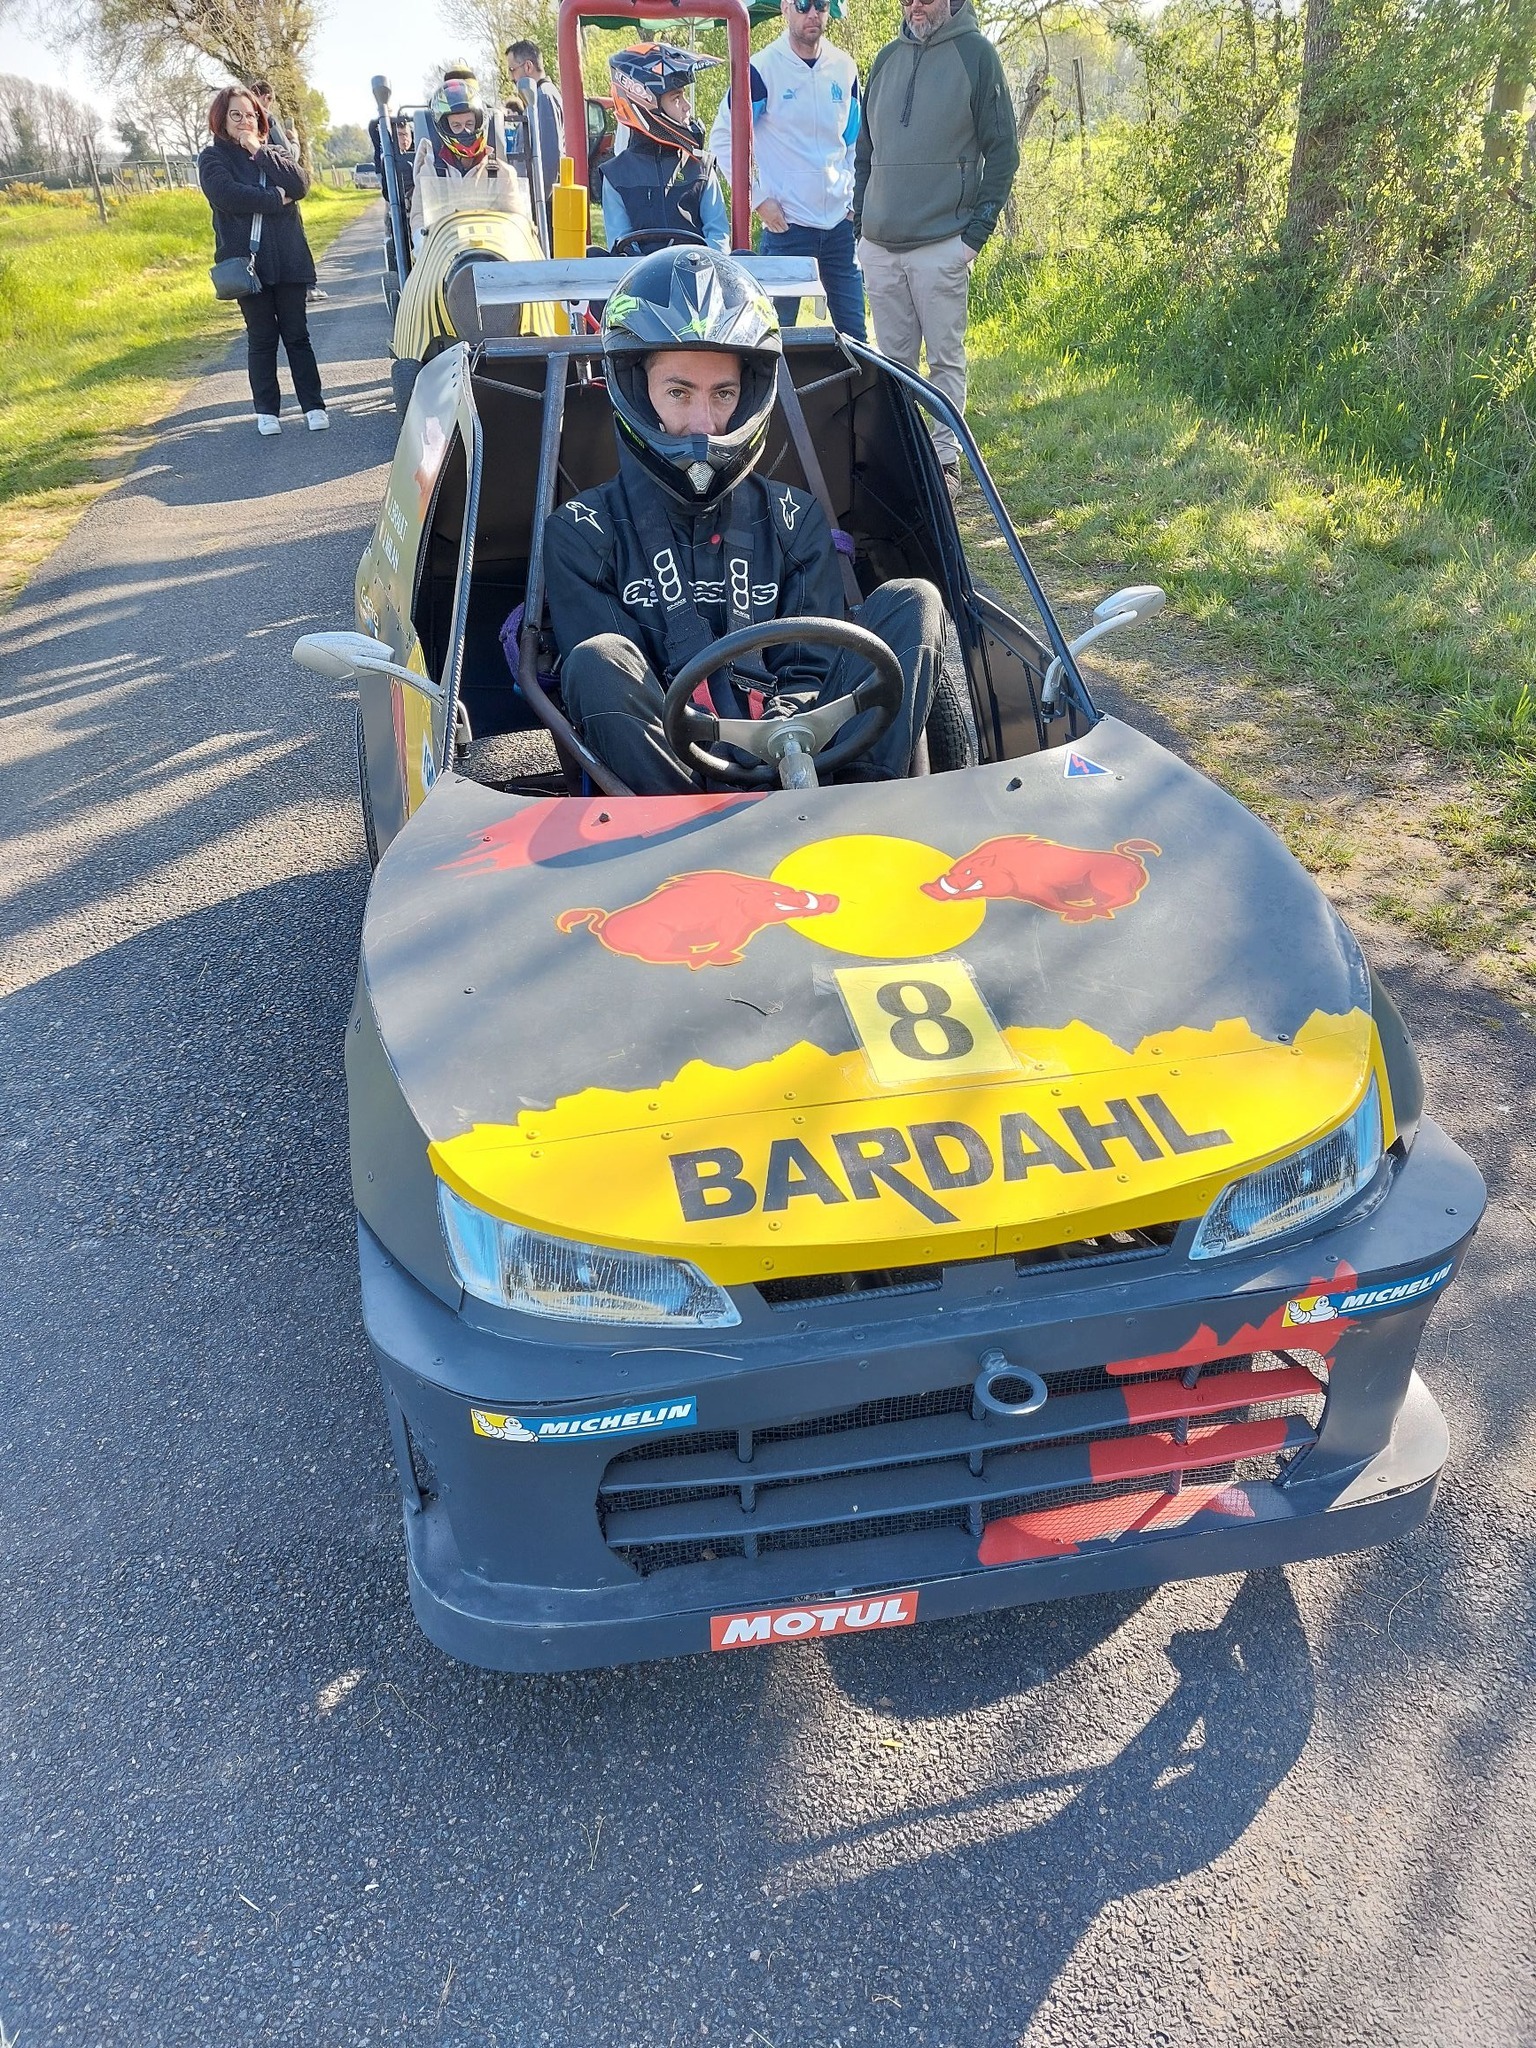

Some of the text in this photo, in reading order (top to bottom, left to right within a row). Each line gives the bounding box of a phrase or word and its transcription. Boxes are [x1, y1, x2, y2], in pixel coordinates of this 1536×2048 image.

[876, 980, 975, 1061] 8
[668, 1093, 1233, 1225] BARDAHL
[1340, 1263, 1453, 1309] MICHELIN
[538, 1403, 692, 1435] MICHELIN
[720, 1598, 909, 1645] MOTUL
